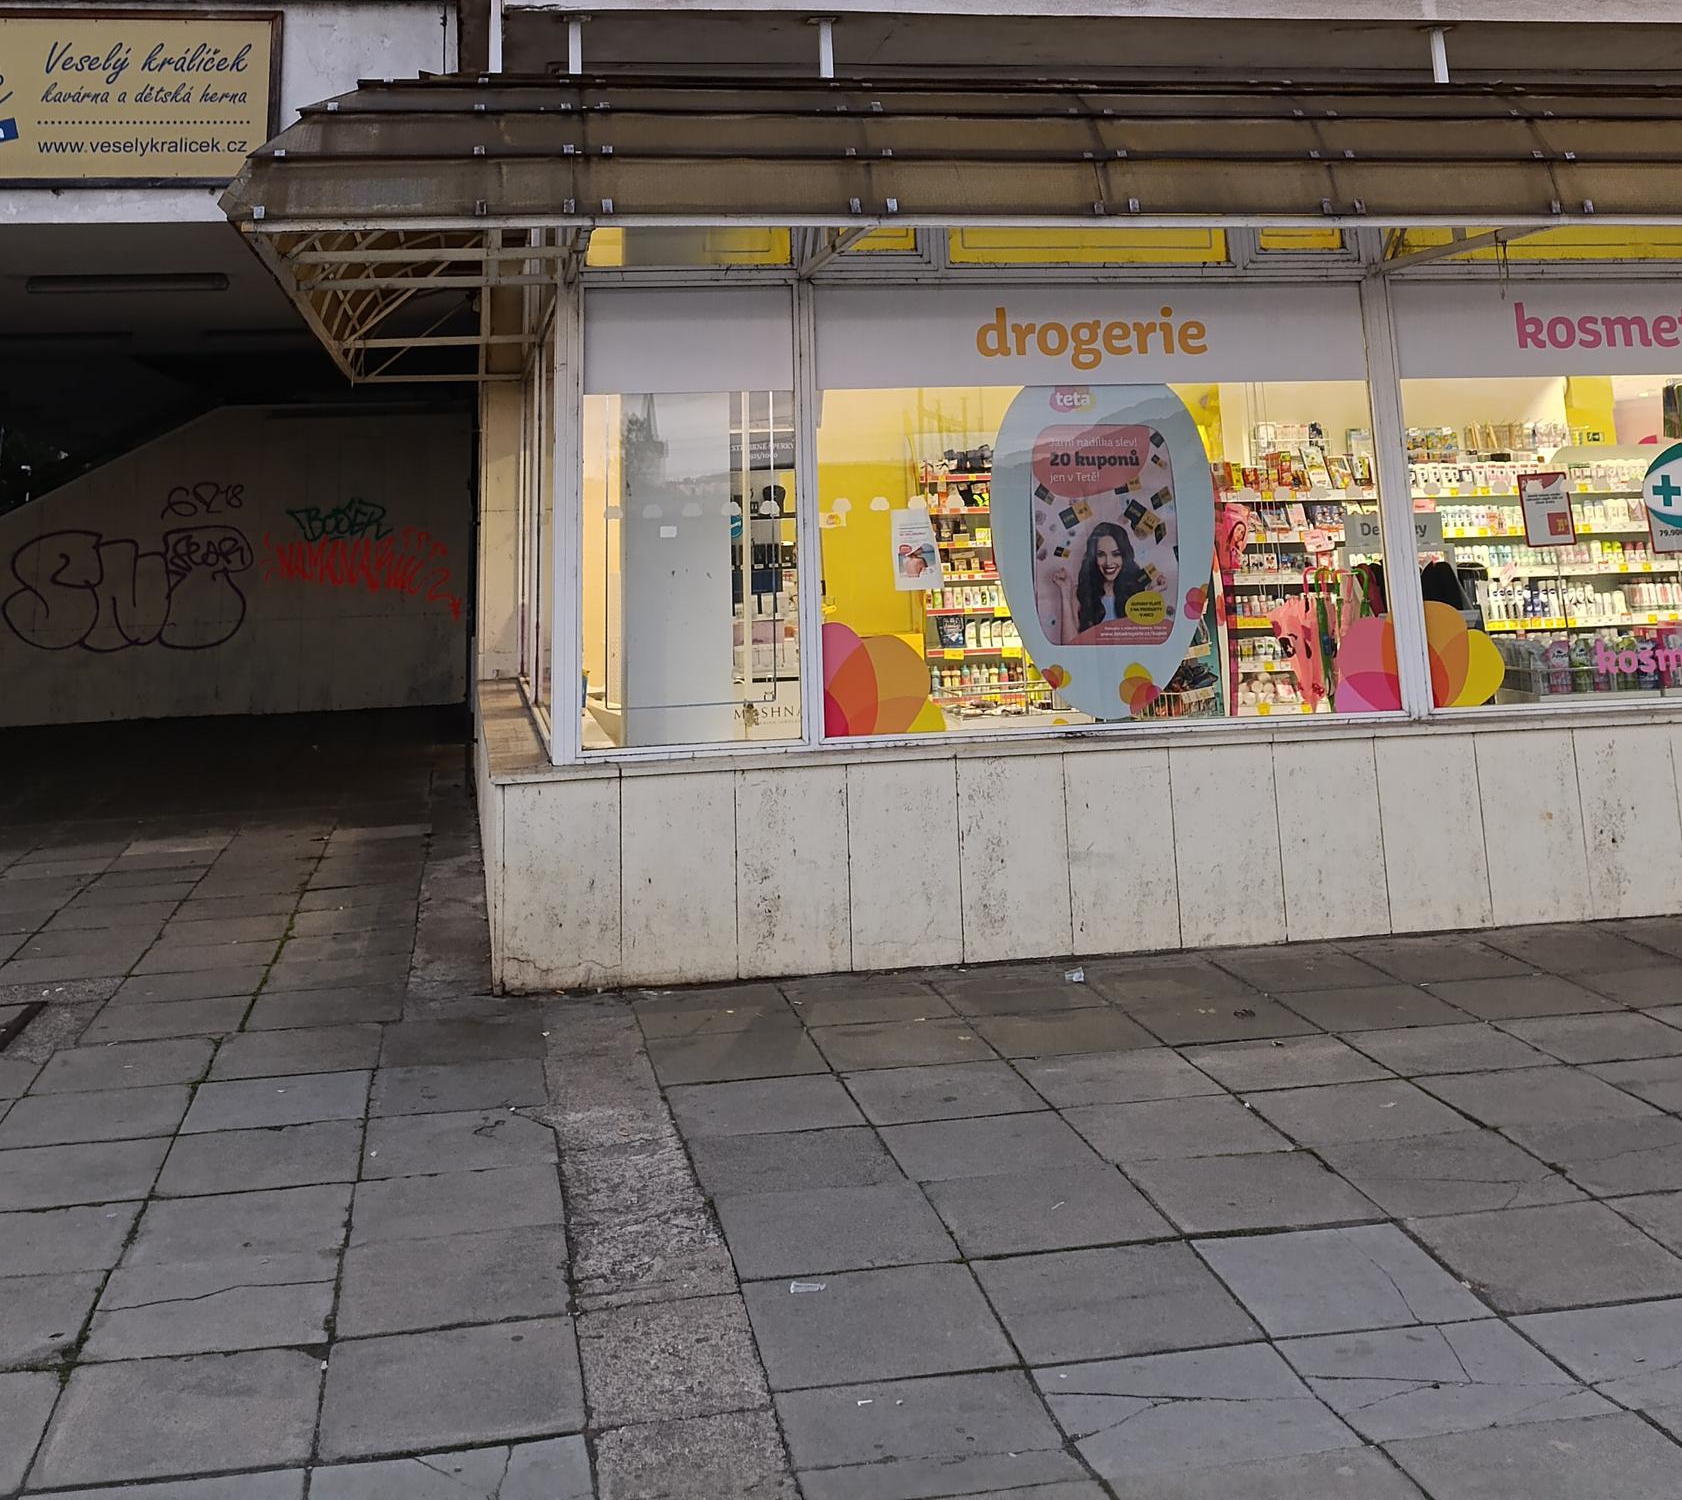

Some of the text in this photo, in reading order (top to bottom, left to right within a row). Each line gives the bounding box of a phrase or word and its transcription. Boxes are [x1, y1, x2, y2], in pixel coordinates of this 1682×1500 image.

[44, 41, 252, 84] Veselý králíček
[41, 82, 247, 104] kavárna a dětská herna
[38, 136, 248, 157] www.veselykralicek.cz
[1514, 302, 1682, 349] kosme
[976, 306, 1209, 370] drogerie
[1055, 391, 1091, 406] teta
[1049, 449, 1140, 470] 20 kuponů
[1050, 471, 1101, 484] jen v Tetě!
[734, 706, 800, 719] MSHN
